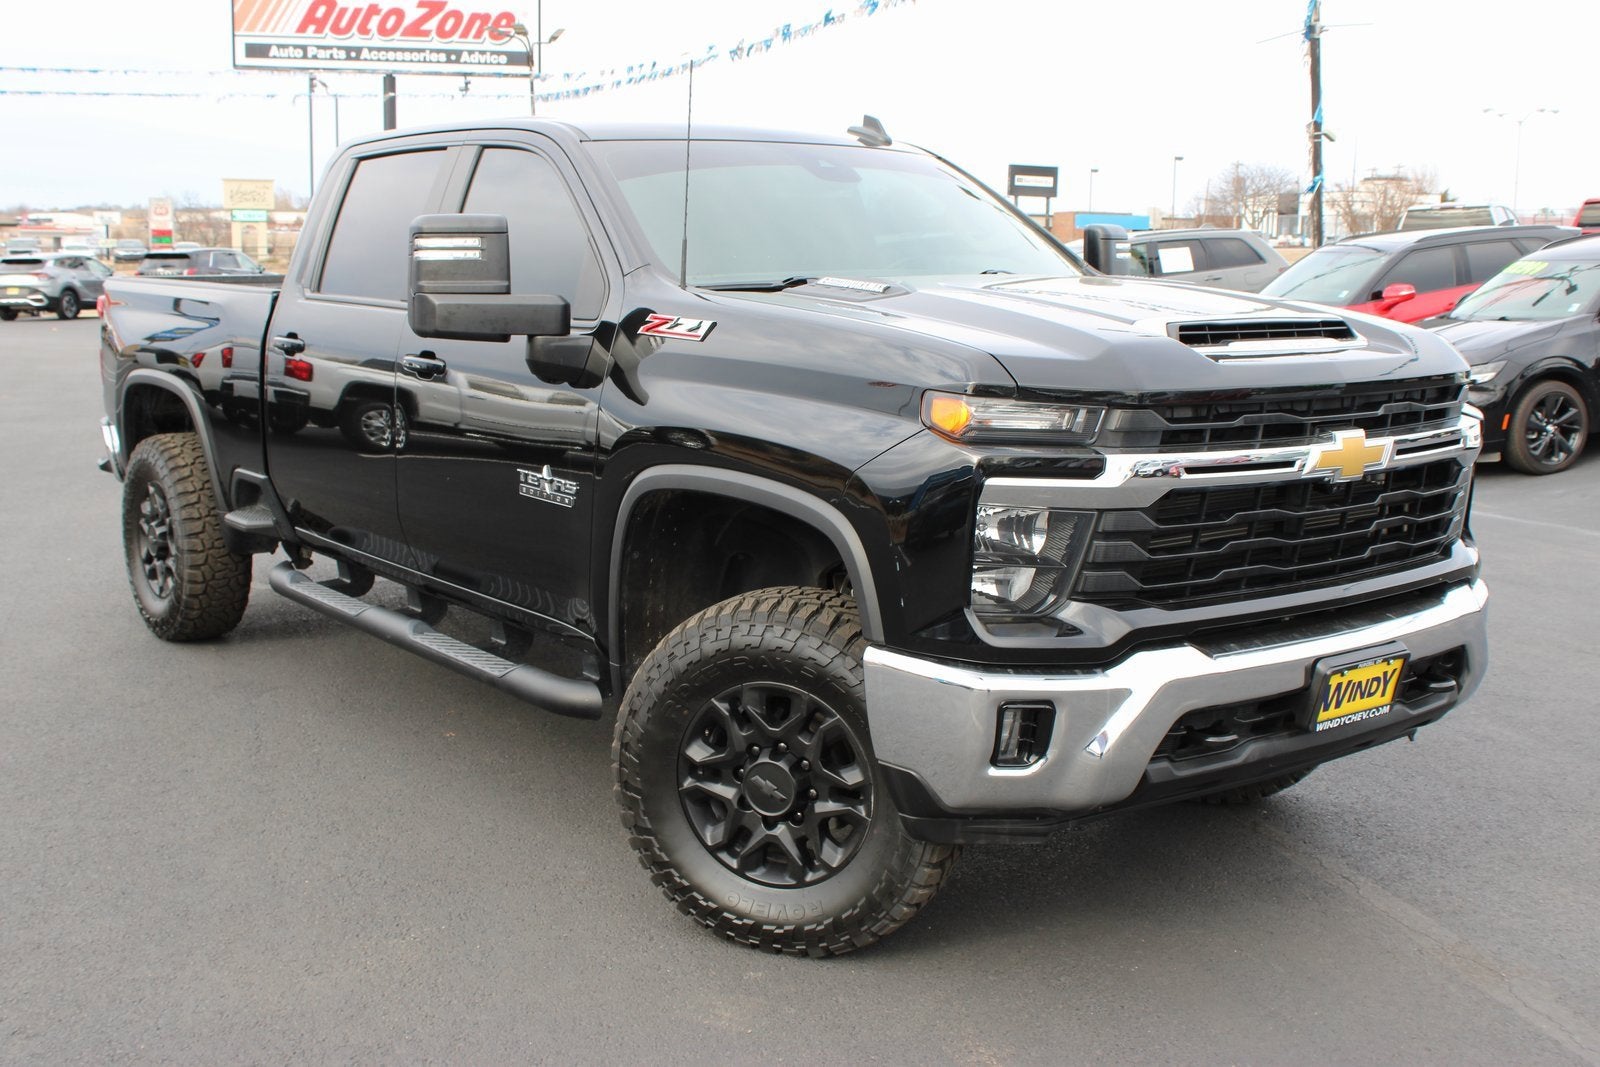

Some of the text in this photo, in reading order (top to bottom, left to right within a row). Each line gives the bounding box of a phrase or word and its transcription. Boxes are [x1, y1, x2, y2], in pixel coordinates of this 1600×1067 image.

[295, 0, 516, 42] AutoZone
[268, 45, 508, 64] Auto Parts Accessories Advice
[637, 313, 717, 342] Z71
[521, 486, 570, 504] EDITION
[1322, 668, 1398, 712] WINDY
[1316, 705, 1391, 732] WINDYCHEV.COM
